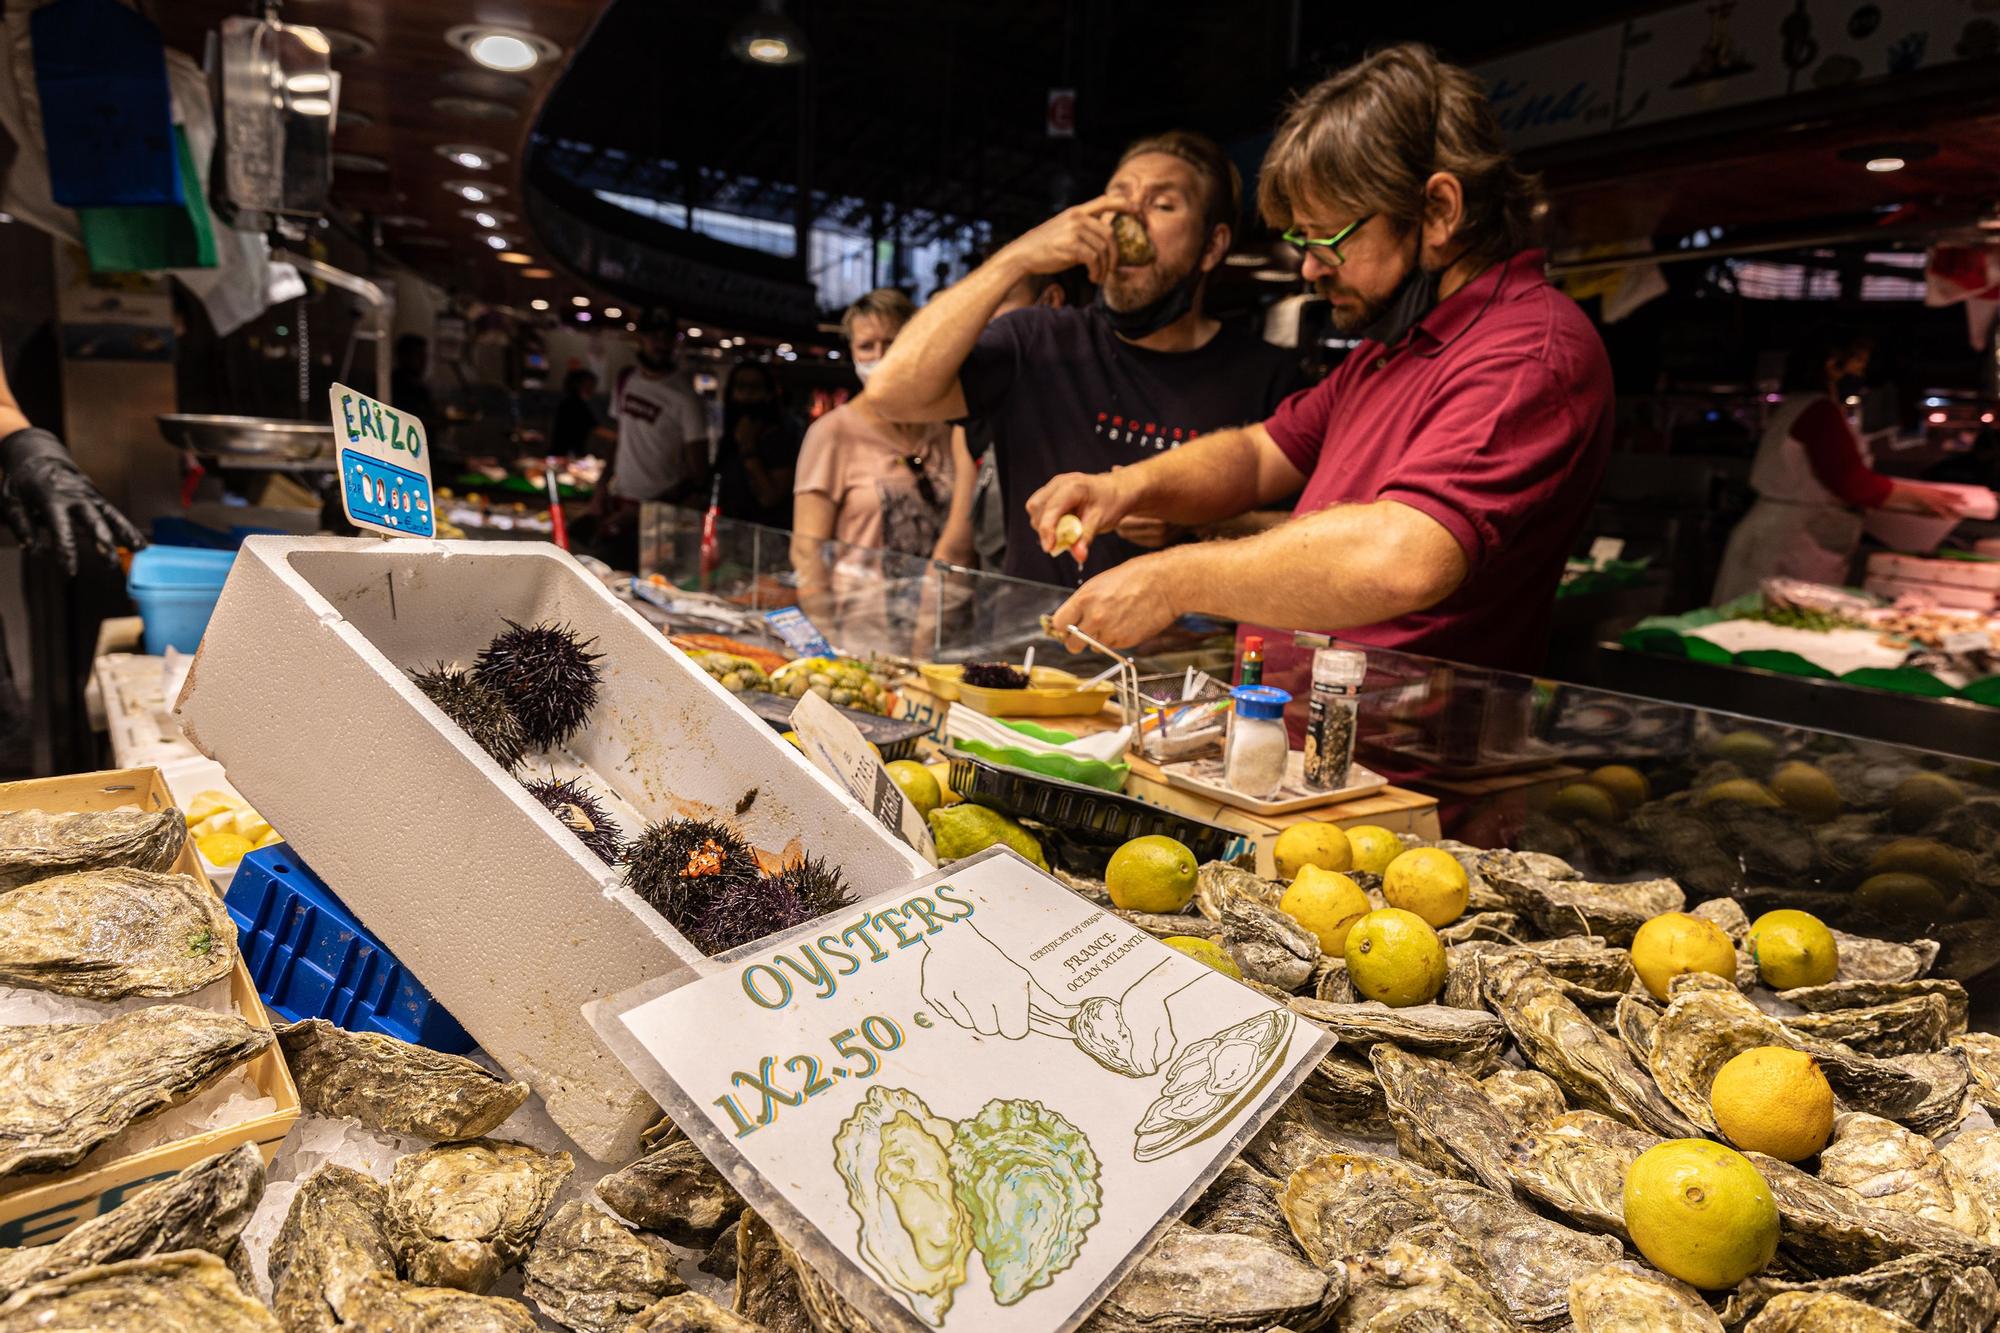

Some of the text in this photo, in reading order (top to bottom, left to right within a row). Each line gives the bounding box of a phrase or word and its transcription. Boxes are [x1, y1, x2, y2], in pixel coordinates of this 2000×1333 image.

[741, 885, 975, 1011] OYSTERS
[1029, 930, 1073, 962] CERTIFICATE
[1066, 932, 1149, 993] OCEAN ATLANTIC
